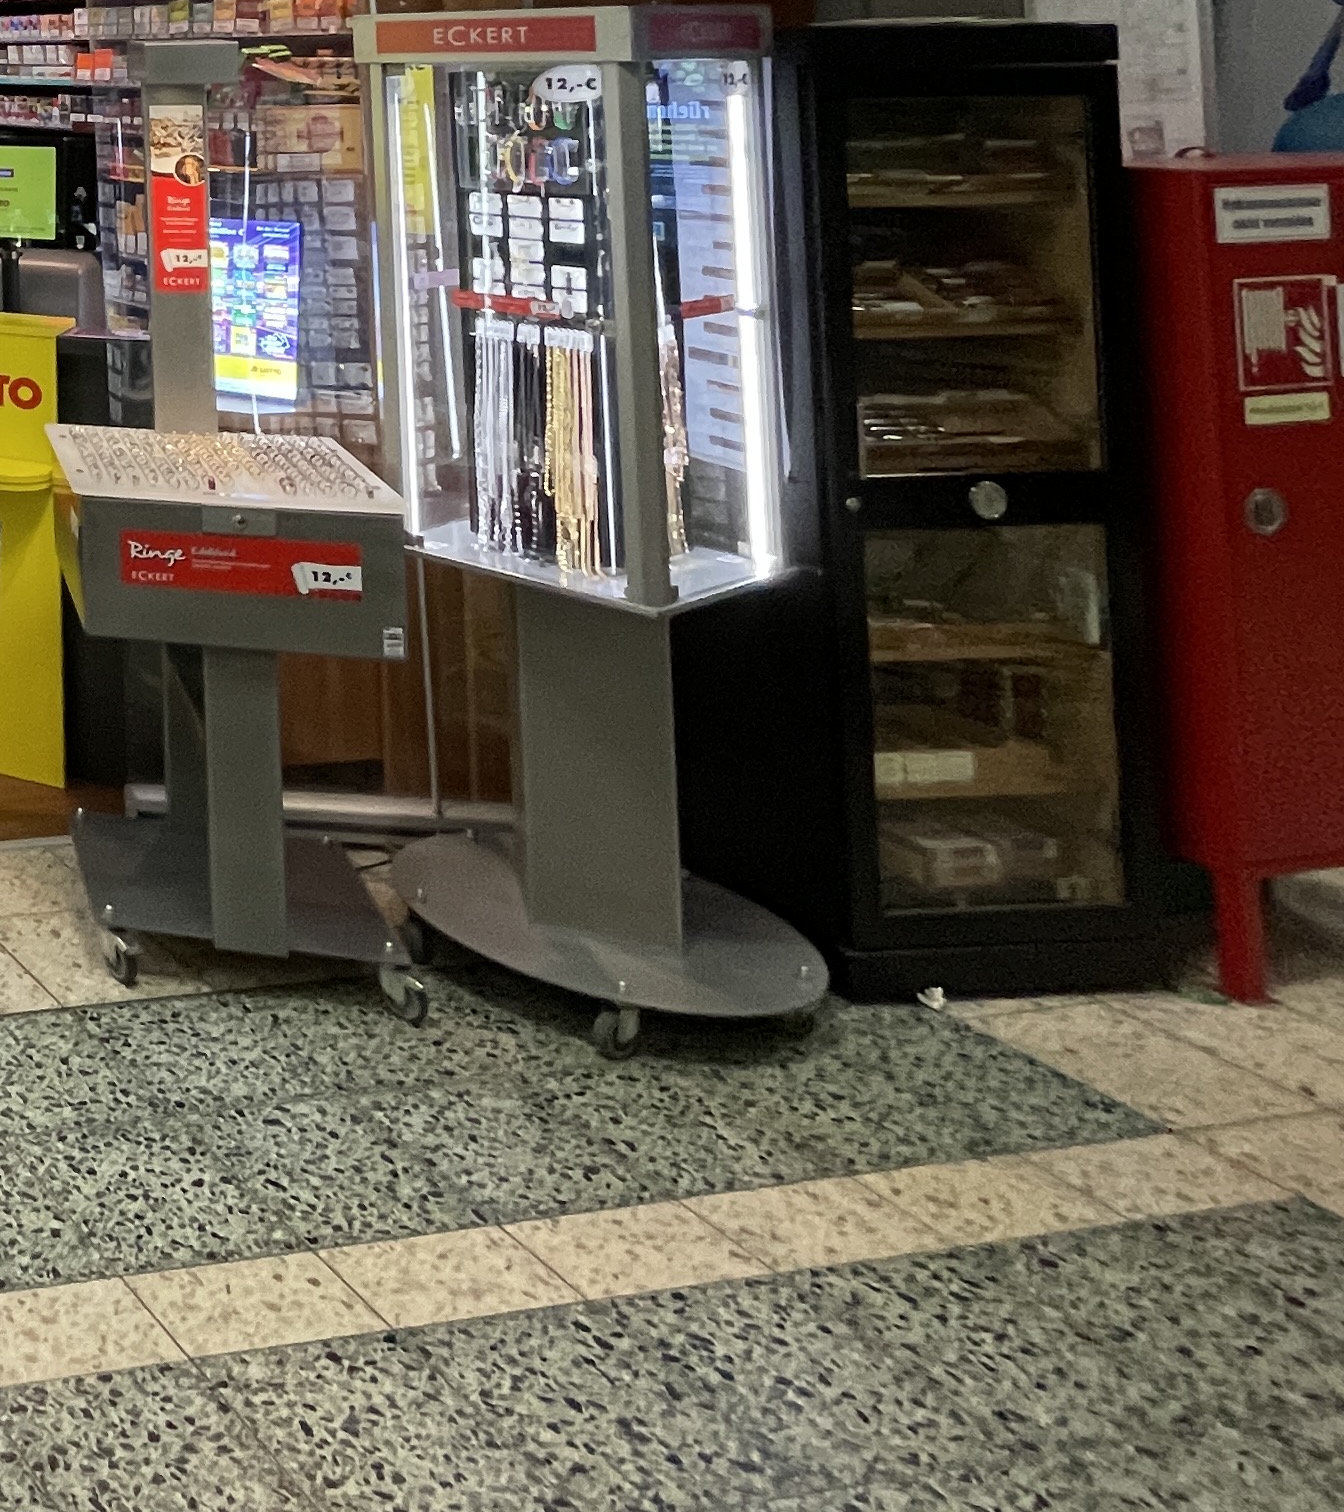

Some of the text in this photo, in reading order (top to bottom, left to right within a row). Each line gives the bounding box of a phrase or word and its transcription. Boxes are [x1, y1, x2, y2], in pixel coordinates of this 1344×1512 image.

[432, 25, 529, 47] ECKERT
[127, 540, 186, 566] Ringe
[131, 570, 175, 582] ECKERT
